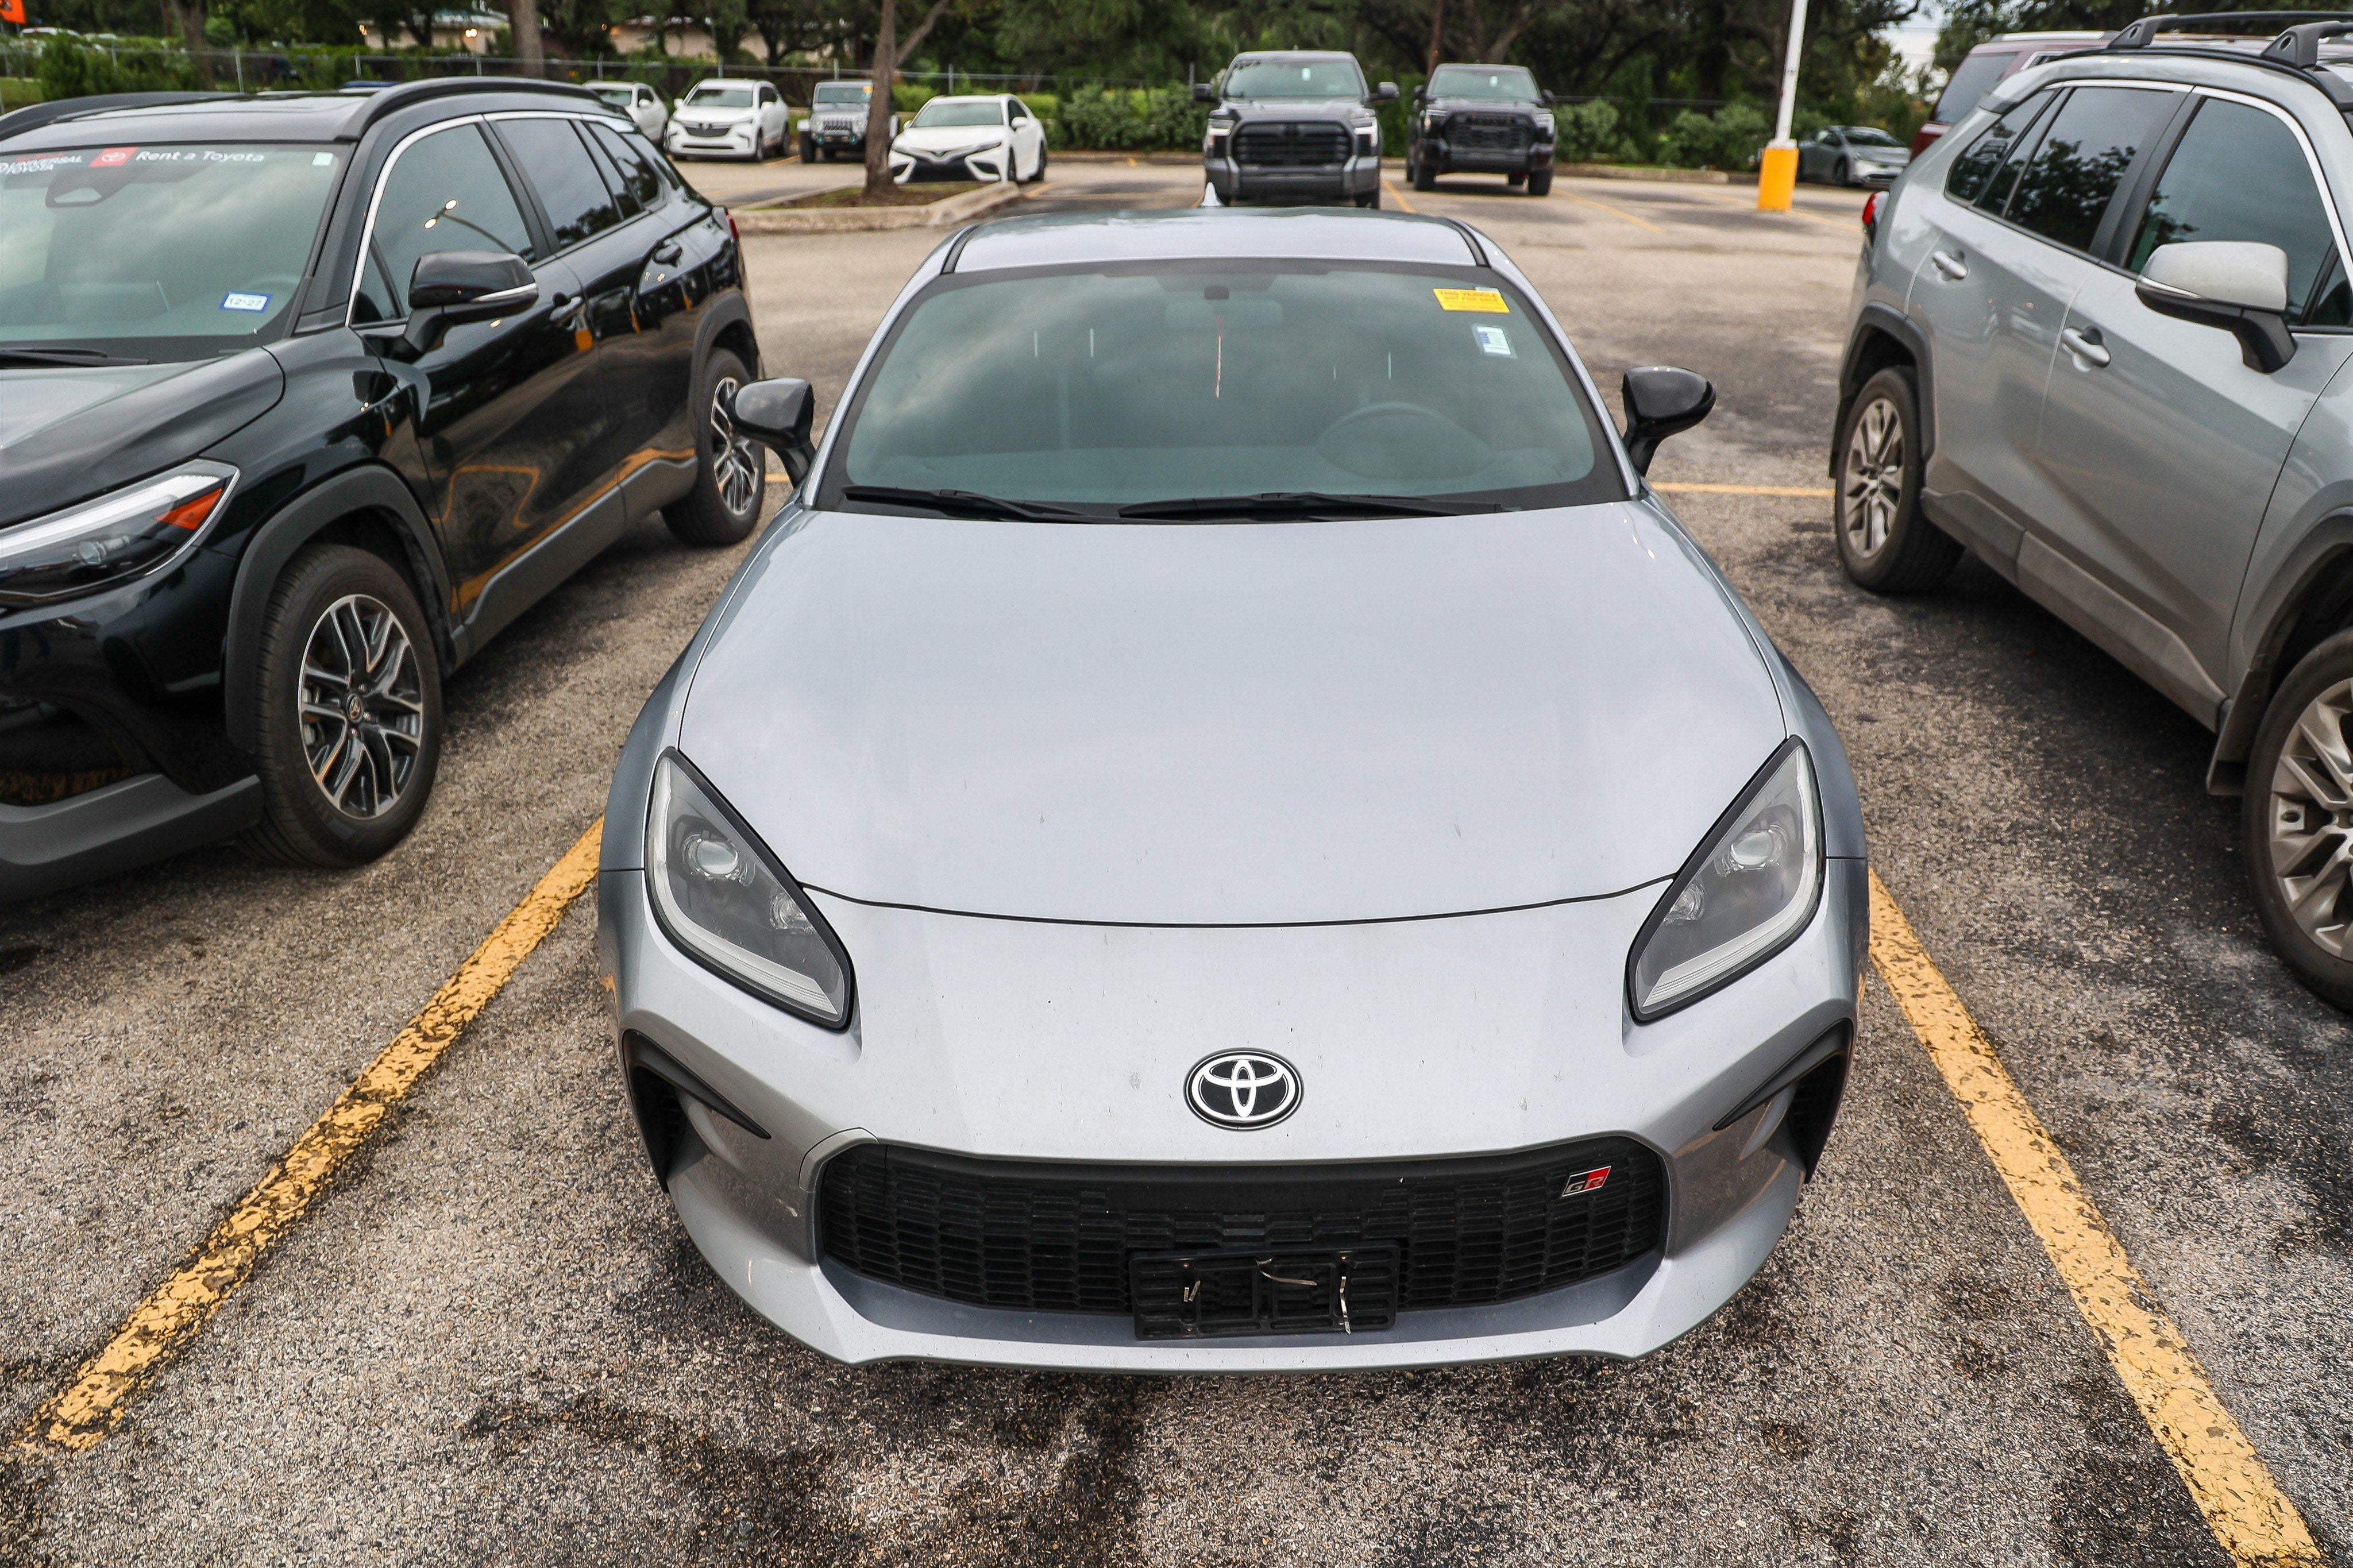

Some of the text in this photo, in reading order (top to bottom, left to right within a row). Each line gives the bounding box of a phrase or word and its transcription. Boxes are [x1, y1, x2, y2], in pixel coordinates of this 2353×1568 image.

[136, 150, 265, 163] Rent a Toyota
[1565, 1176, 1604, 1194] GR
